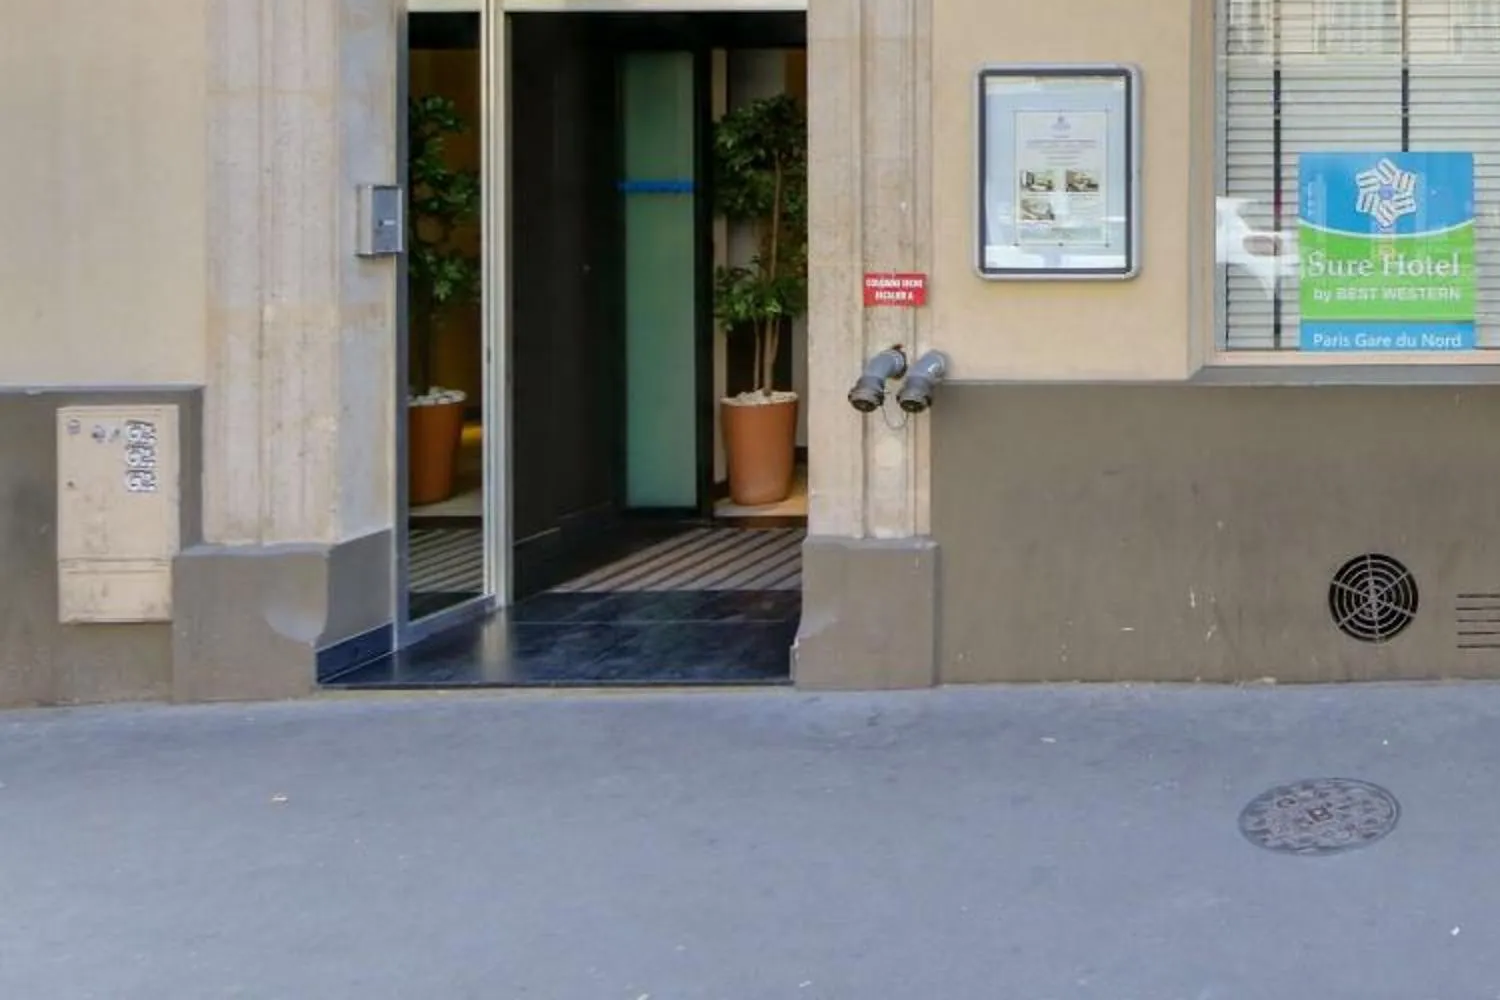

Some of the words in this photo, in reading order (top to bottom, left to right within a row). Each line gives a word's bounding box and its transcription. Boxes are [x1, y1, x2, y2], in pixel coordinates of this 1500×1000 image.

[1307, 251, 1374, 277] Sure
[1383, 251, 1460, 277] Hotel
[1313, 288, 1332, 303] by
[1335, 286, 1379, 300] BEST
[1381, 286, 1462, 300] WESTERN
[1313, 333, 1352, 348] Paris
[1354, 333, 1393, 348] Gare
[1395, 331, 1418, 348] du
[1421, 331, 1462, 348] Nord
